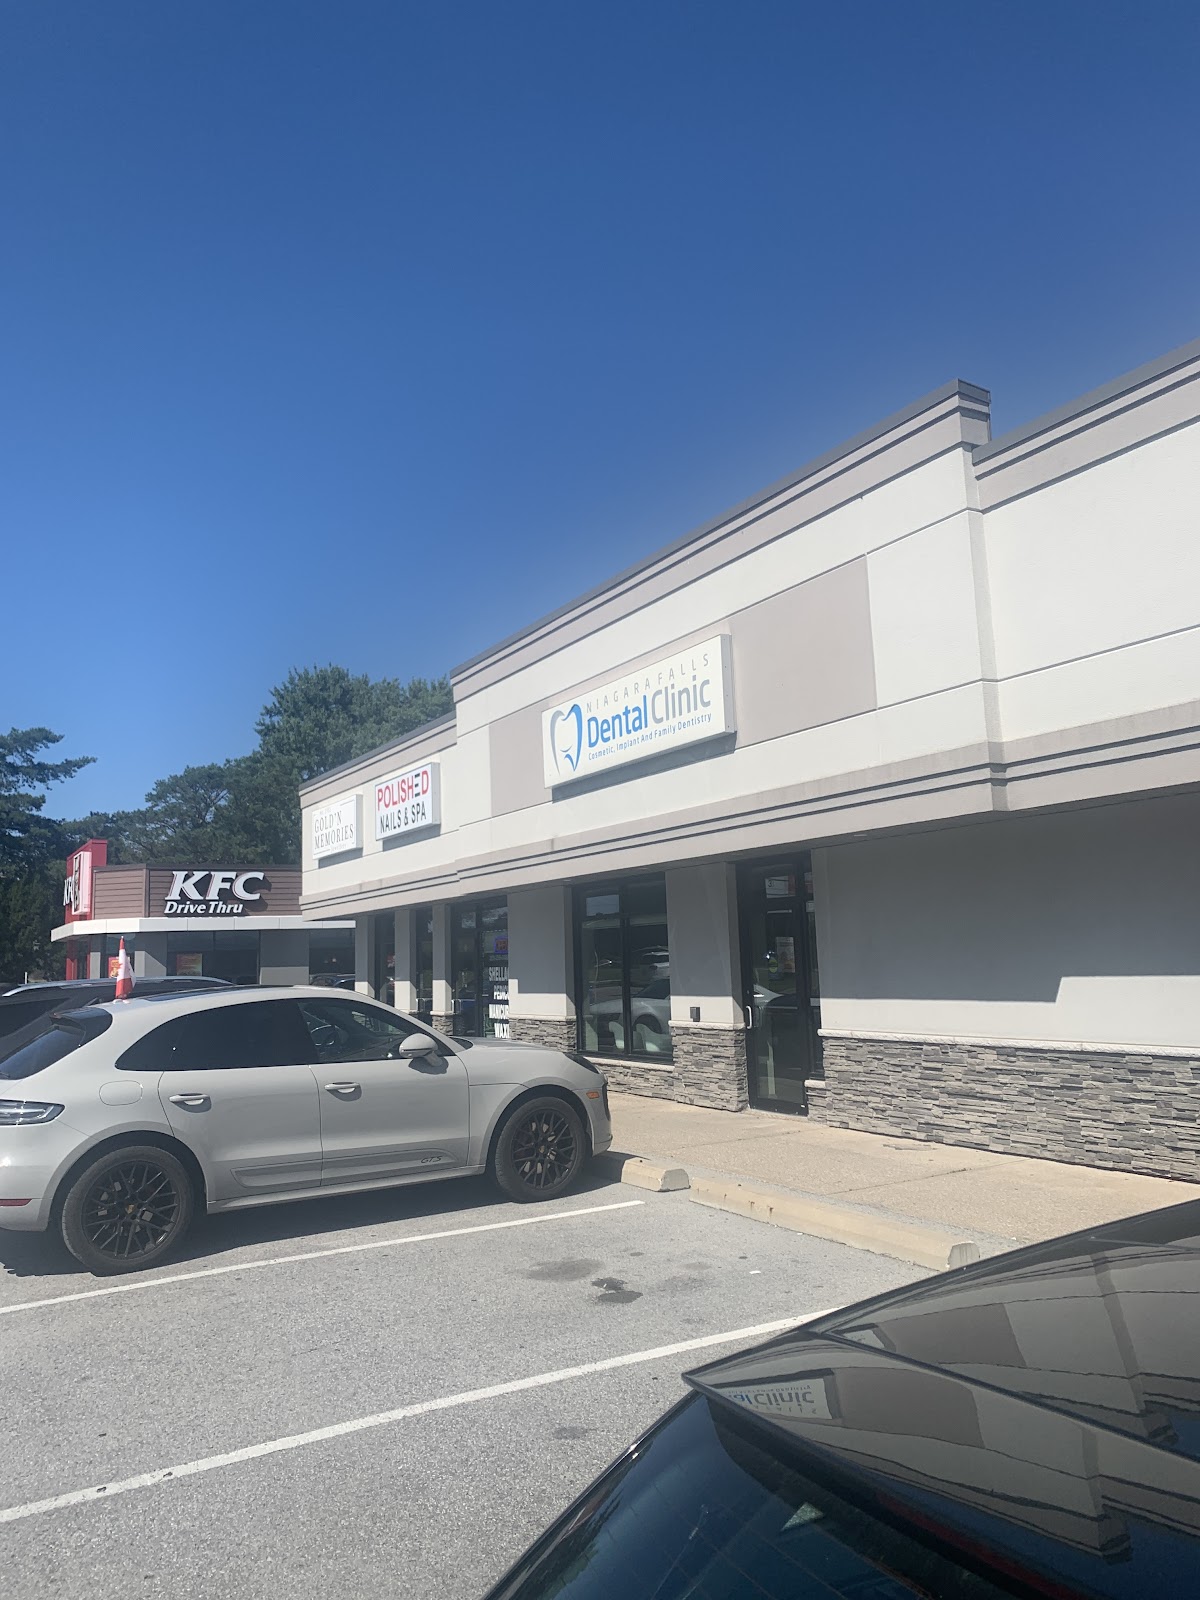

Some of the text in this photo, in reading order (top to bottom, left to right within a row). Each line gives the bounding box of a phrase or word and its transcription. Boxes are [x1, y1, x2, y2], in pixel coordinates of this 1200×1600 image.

[588, 674, 711, 748] Dental Clinic
[588, 713, 712, 761] Cosmetic, Implant And Family Dentistry
[377, 770, 430, 811] POLISHED
[314, 810, 342, 834] GOLD'N
[380, 801, 427, 834] NAILS & SPA
[314, 823, 354, 850] MEMORIES
[164, 870, 265, 901] KFC
[164, 901, 243, 914] Drive Thru
[488, 966, 509, 982] SHELLA
[493, 1022, 510, 1039] WAXI
[420, 1155, 443, 1164] GTS
